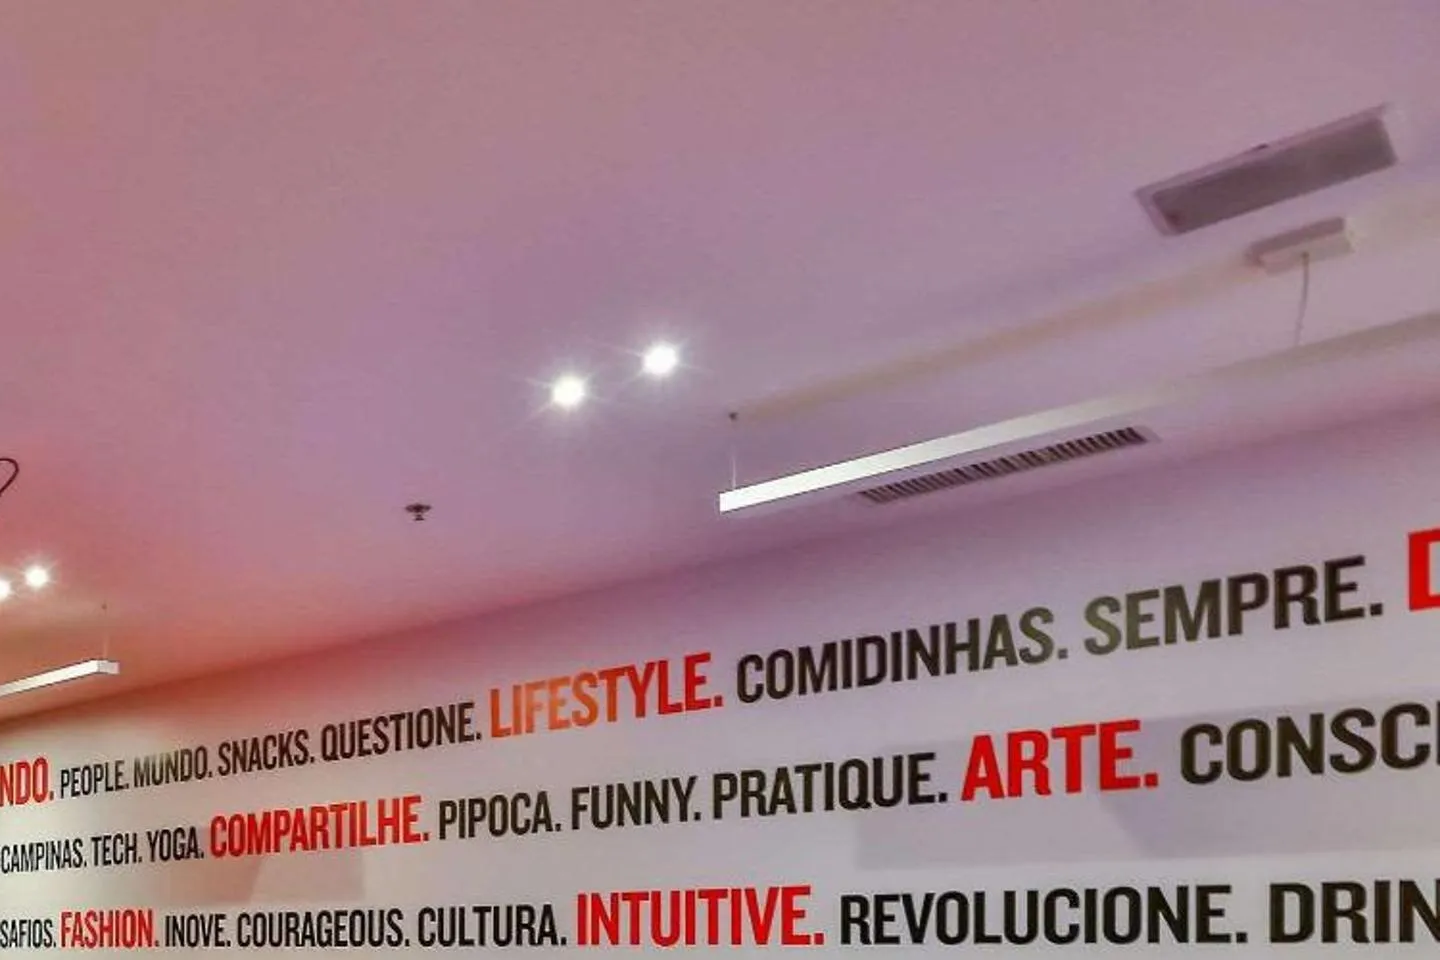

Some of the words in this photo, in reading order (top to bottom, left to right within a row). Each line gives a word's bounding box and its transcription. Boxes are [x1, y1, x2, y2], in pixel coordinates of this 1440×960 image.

[60, 760, 130, 799] PEOPLE.
[133, 749, 213, 789] MUNDO.
[219, 731, 316, 776] SNACKS.
[321, 702, 482, 763] QUESTIONE.
[490, 651, 723, 738] LIFESTYLE.
[736, 607, 1068, 703] COMIDINHAS.
[1084, 555, 1383, 656] SEMPRE.
[1, 838, 87, 874] CAMPINAS.
[91, 834, 142, 868] TECH.
[146, 825, 205, 863] YOGA.
[210, 795, 429, 858] COMPARTILHE.
[439, 790, 562, 840] PIPOCA.
[572, 776, 700, 831] FUNNY.
[712, 752, 947, 820] PRATIQUE.
[961, 719, 1159, 801] ARTE.
[1180, 700, 1440, 785] CONSC
[60, 909, 159, 948] FASHION.
[165, 913, 231, 948] INOVE.
[237, 907, 410, 948] COURAGEOUS.
[418, 904, 566, 948] CULTURA.
[577, 885, 824, 946] INTUITIVE.
[841, 884, 1247, 945] REVOLUCIONE.
